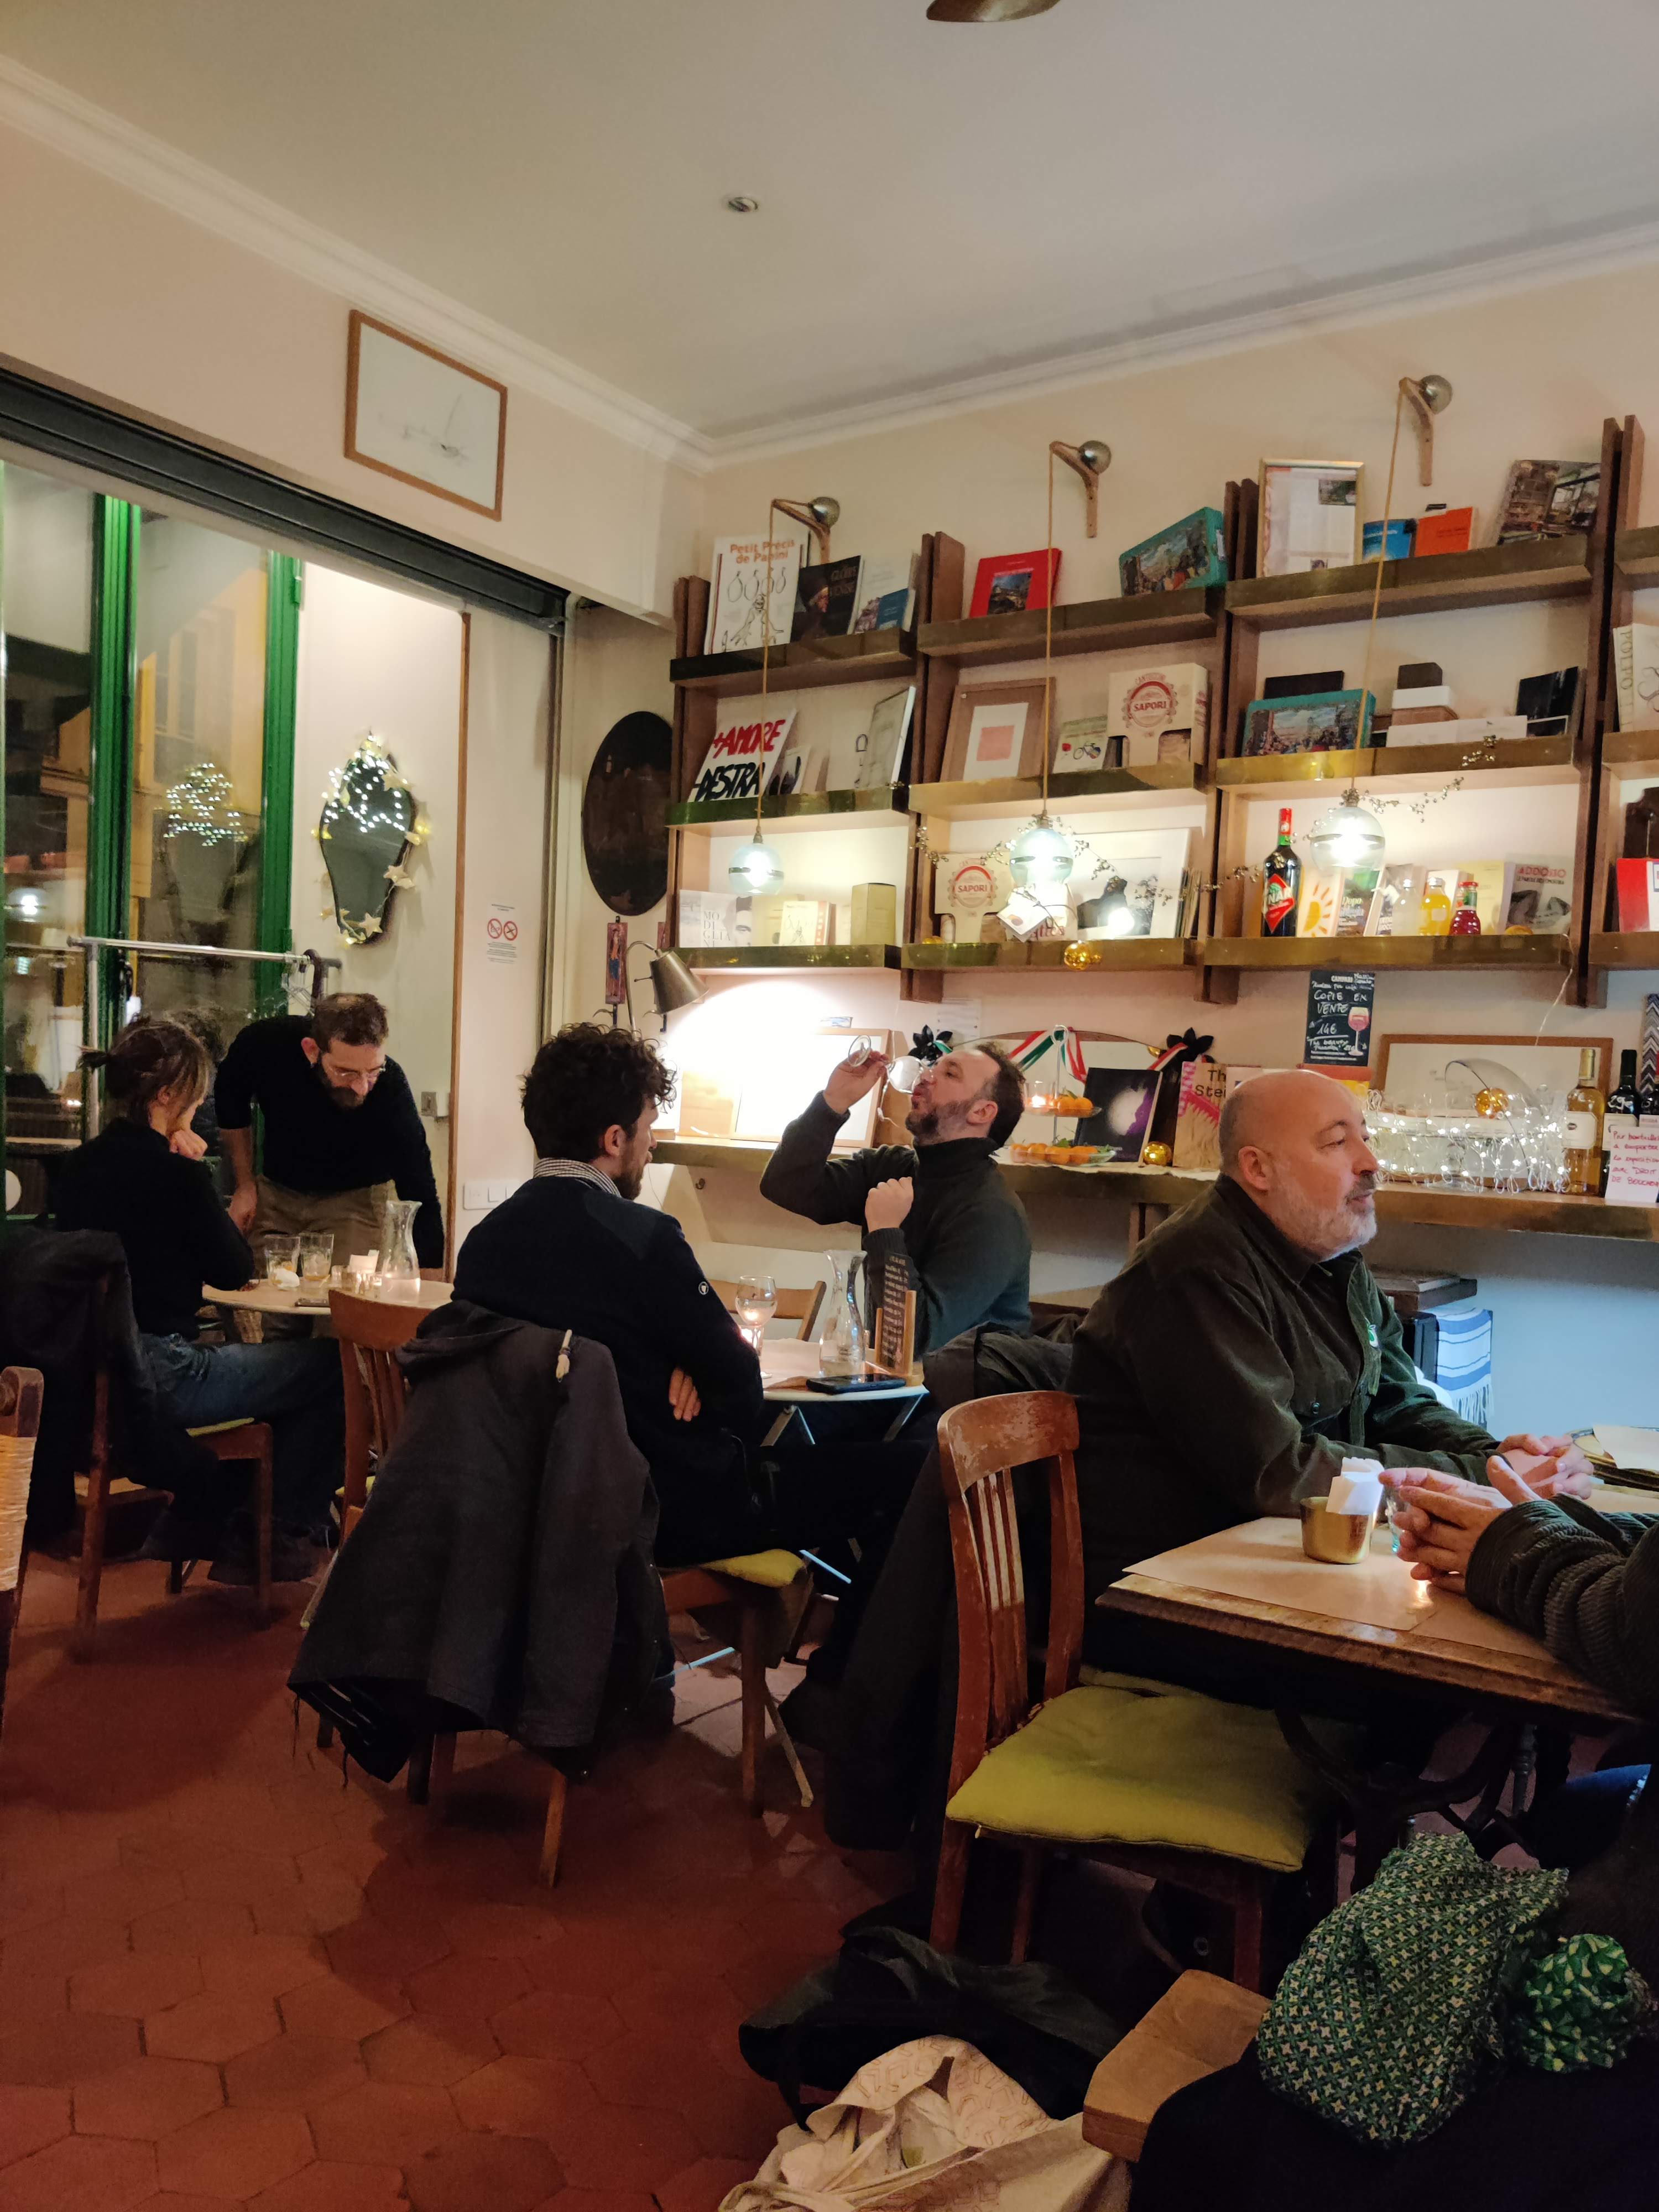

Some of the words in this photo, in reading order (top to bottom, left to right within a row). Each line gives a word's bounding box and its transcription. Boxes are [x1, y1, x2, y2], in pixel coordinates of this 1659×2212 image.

[730, 544, 758, 553] Petit
[736, 554, 750, 564] de
[1134, 701, 1167, 712] SAPORI
[958, 885, 987, 893] SAPORI
[703, 911, 719, 920] MO
[703, 920, 714, 930] DI
[703, 930, 731, 941] GLIA
[1314, 990, 1343, 1001] COPIE
[1208, 1070, 1226, 1082] Th
[1195, 1084, 1226, 1097] Stei
